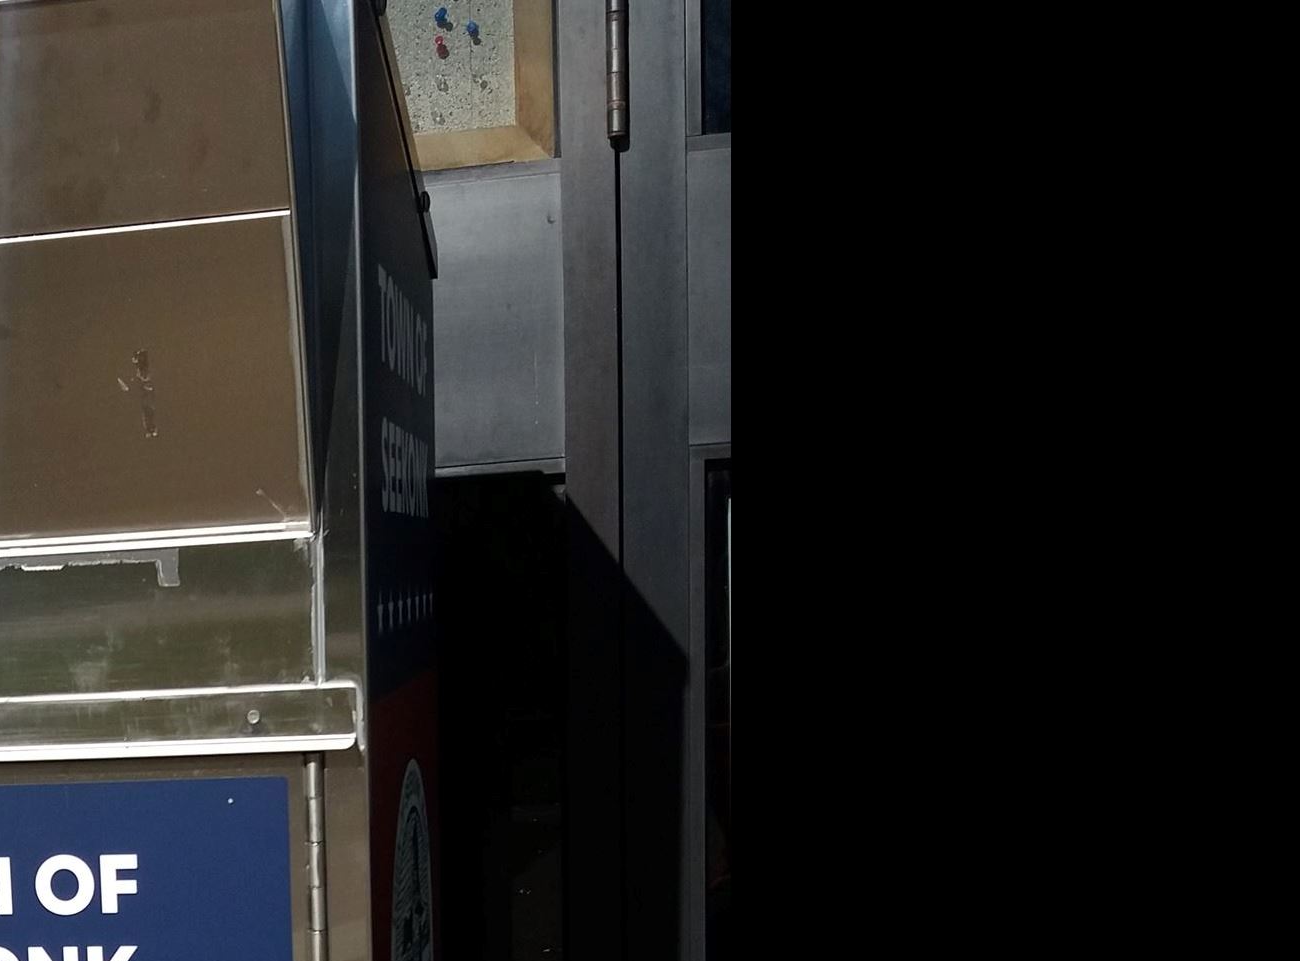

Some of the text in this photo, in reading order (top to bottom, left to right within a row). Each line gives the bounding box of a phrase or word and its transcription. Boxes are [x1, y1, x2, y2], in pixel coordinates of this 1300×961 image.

[378, 264, 428, 397] TOWN OF
[381, 416, 429, 518] SEEKONK
[35, 854, 138, 916] OF
